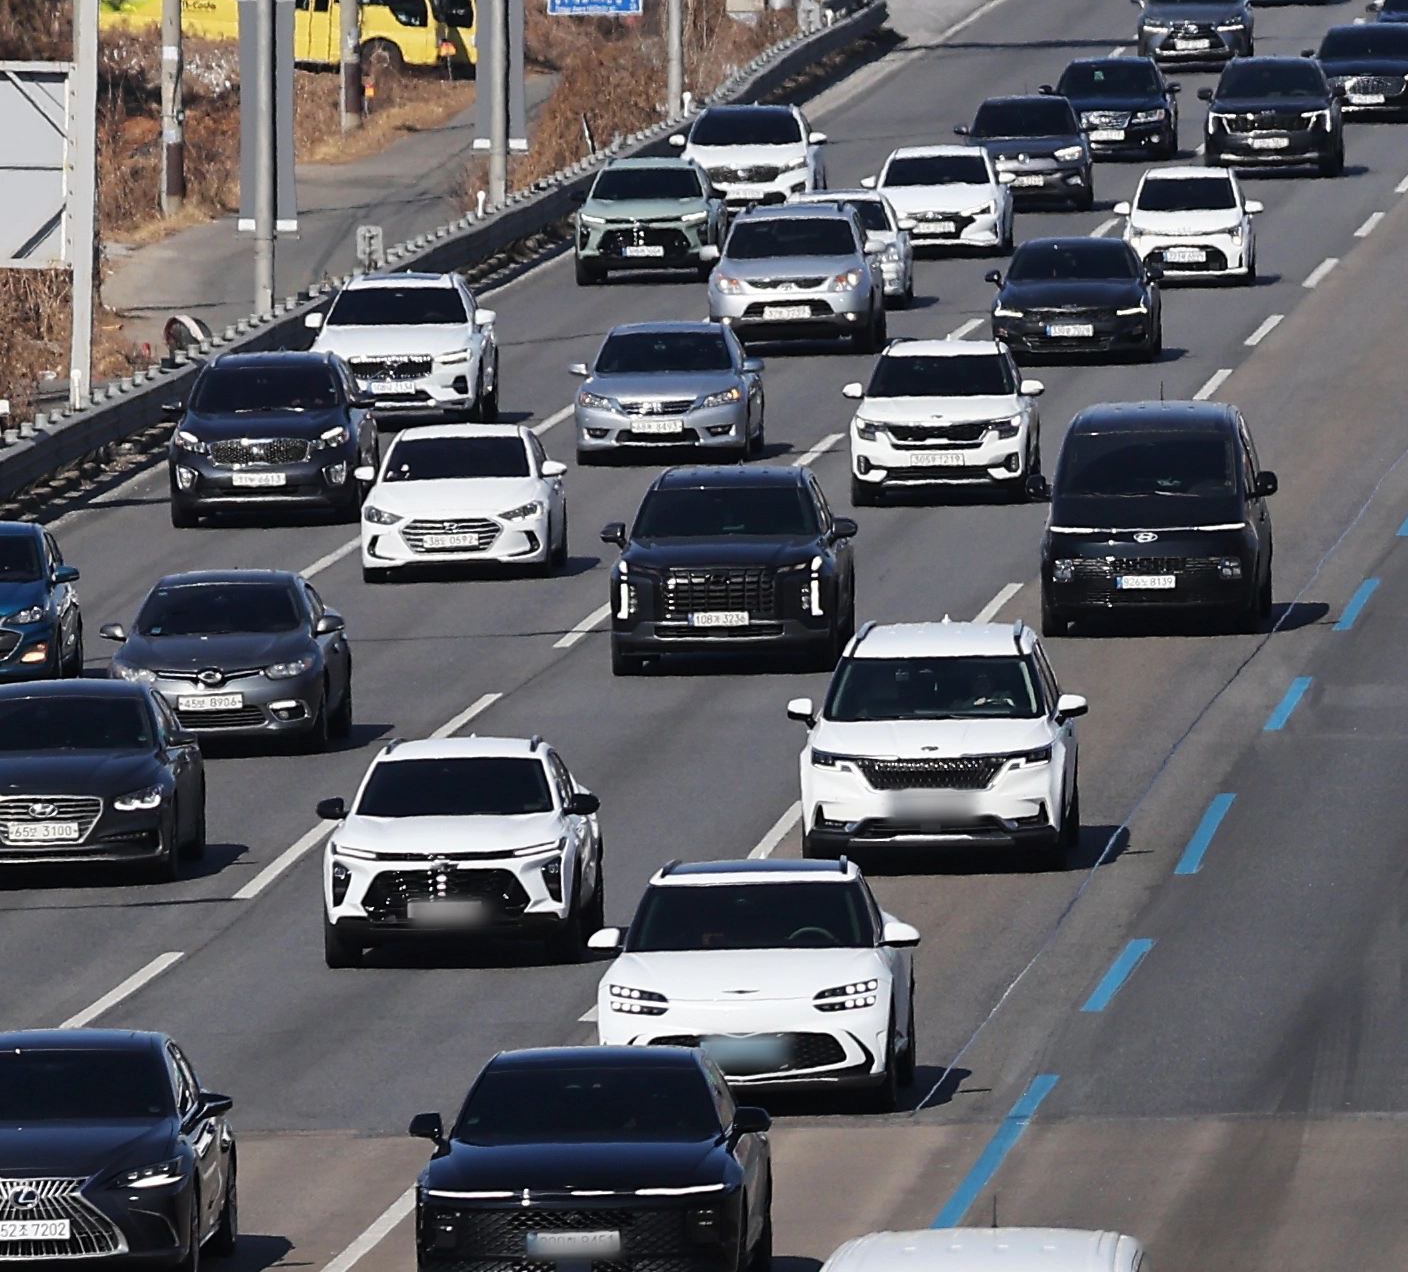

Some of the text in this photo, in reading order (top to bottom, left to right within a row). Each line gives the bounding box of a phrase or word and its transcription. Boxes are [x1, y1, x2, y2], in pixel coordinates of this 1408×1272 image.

[1150, 576, 1173, 587] 8139
[209, 697, 236, 708] 8906
[43, 825, 73, 837] 3100
[33, 1222, 70, 1238] 7202
